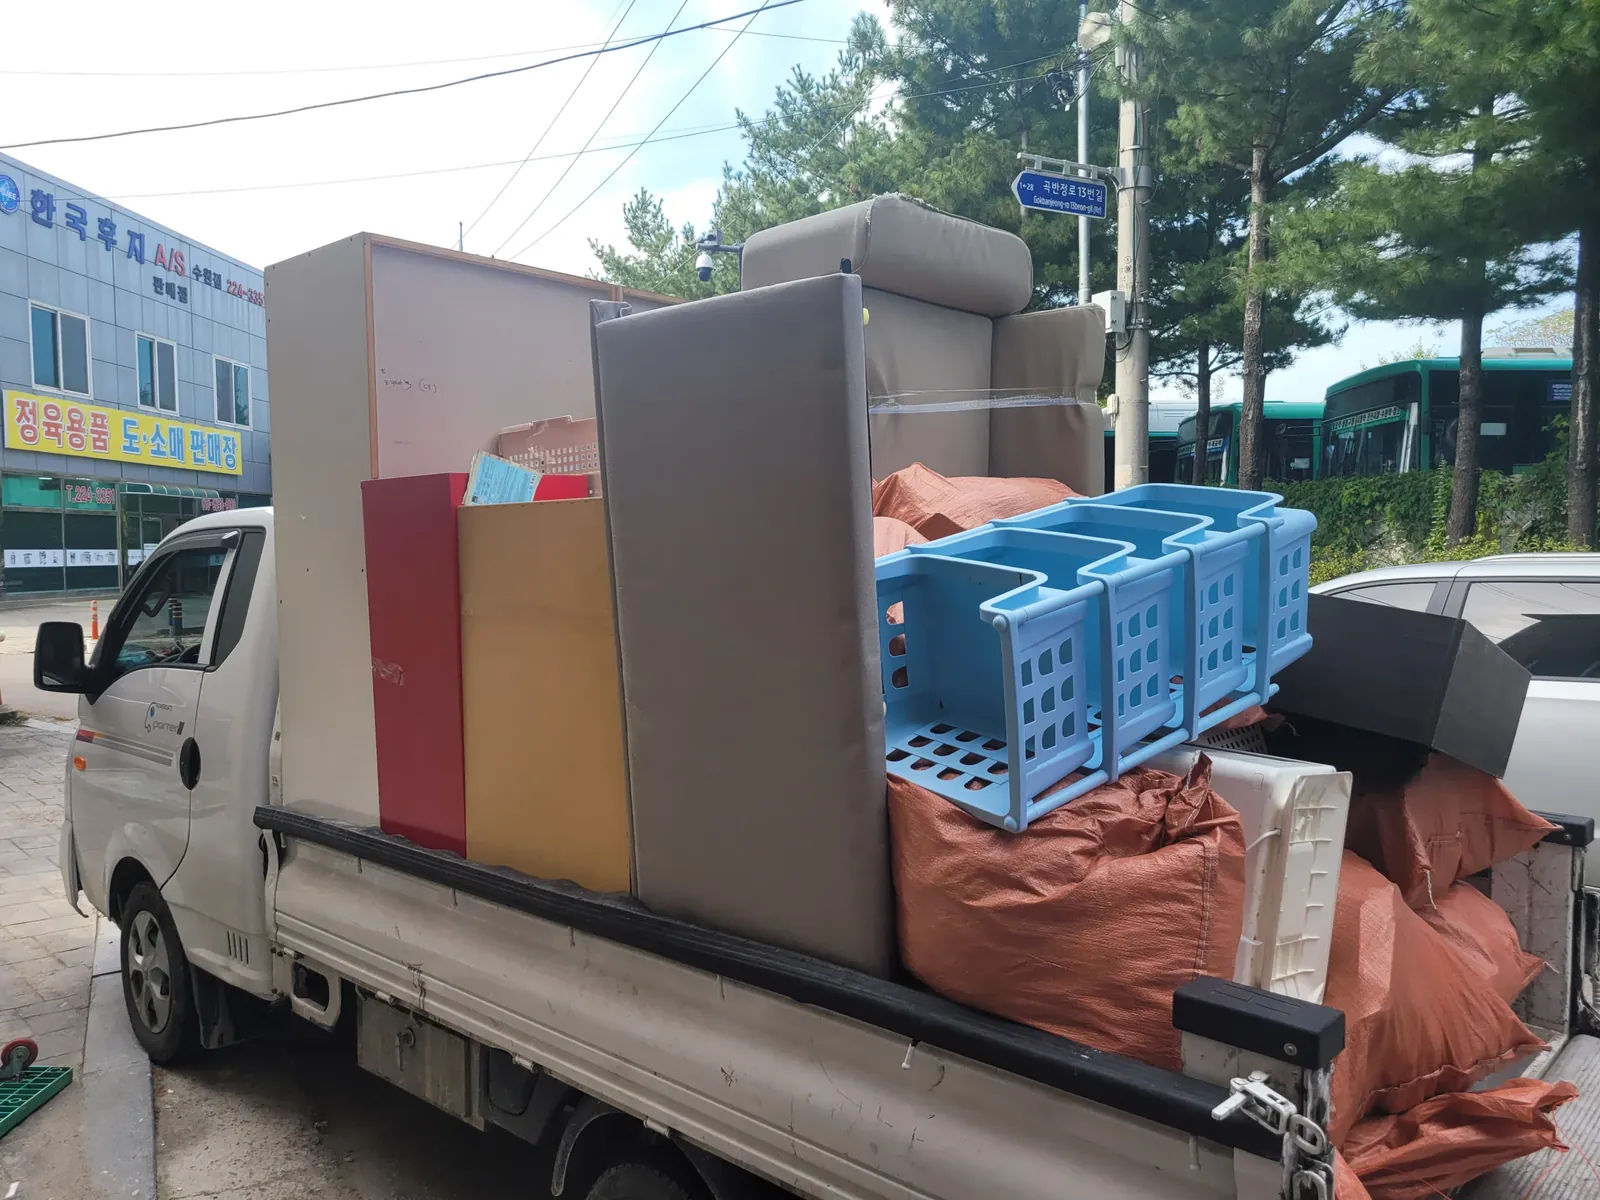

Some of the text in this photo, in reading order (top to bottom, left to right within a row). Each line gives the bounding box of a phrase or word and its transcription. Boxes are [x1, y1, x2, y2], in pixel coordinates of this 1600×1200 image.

[31, 189, 145, 265] 한국후지
[154, 243, 186, 277] A/S
[192, 264, 222, 291] 수원점
[15, 398, 109, 453] 정육용품
[190, 428, 238, 470] 판매장
